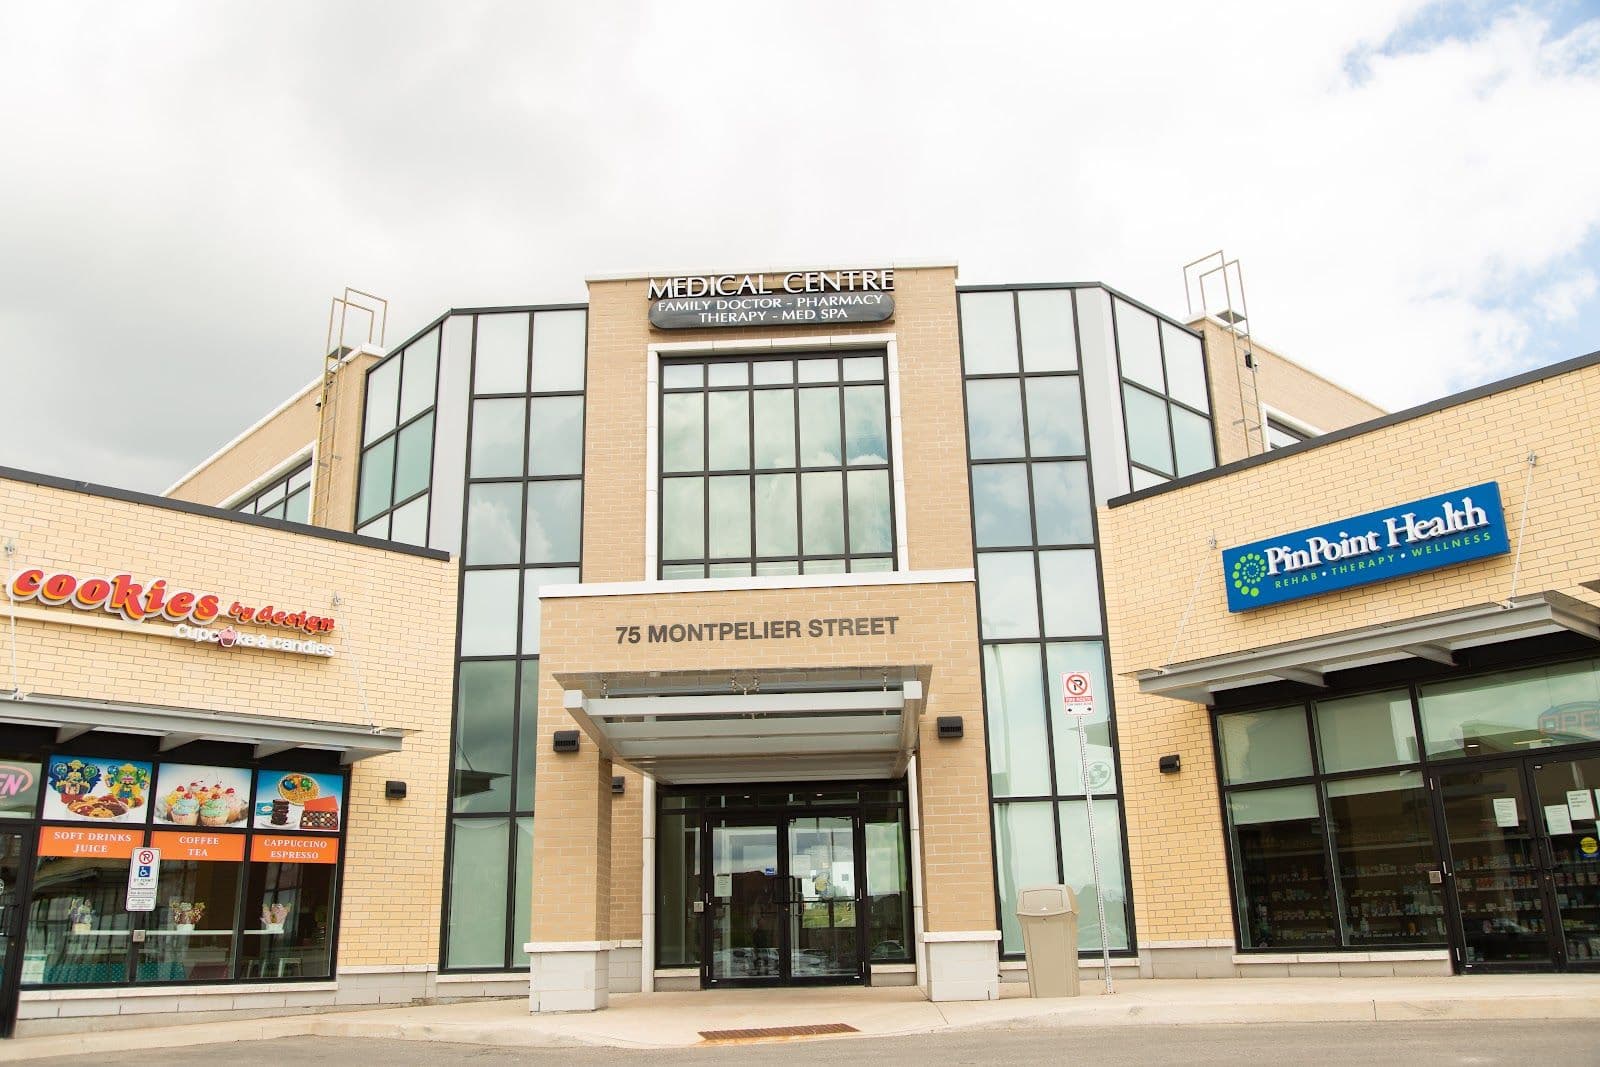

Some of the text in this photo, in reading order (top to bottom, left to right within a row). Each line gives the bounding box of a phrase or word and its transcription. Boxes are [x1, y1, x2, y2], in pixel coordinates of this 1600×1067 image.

[647, 270, 895, 300] MEDICAL CENTRE
[658, 300, 712, 312] FAMILY
[716, 298, 782, 310] DOCTOR
[797, 294, 884, 308] PHARMACY
[698, 311, 767, 323] THERAPY
[782, 309, 817, 321] MED
[820, 308, 848, 320] SPA
[1264, 496, 1490, 577] PinPoint Health
[1274, 532, 1492, 589] REHAB THERAPY WELLNESS
[10, 568, 335, 633] cookies by design
[615, 616, 900, 645] 75 MONTPELIER STREET
[272, 636, 335, 656] candies
[54, 831, 132, 842] SOFT DRINKS
[178, 835, 220, 845] COFFEE
[263, 839, 328, 849] CAPPUCCINO
[73, 843, 108, 853] JUICE
[187, 848, 209, 857] TEA
[270, 850, 320, 859] ESPRESSO
